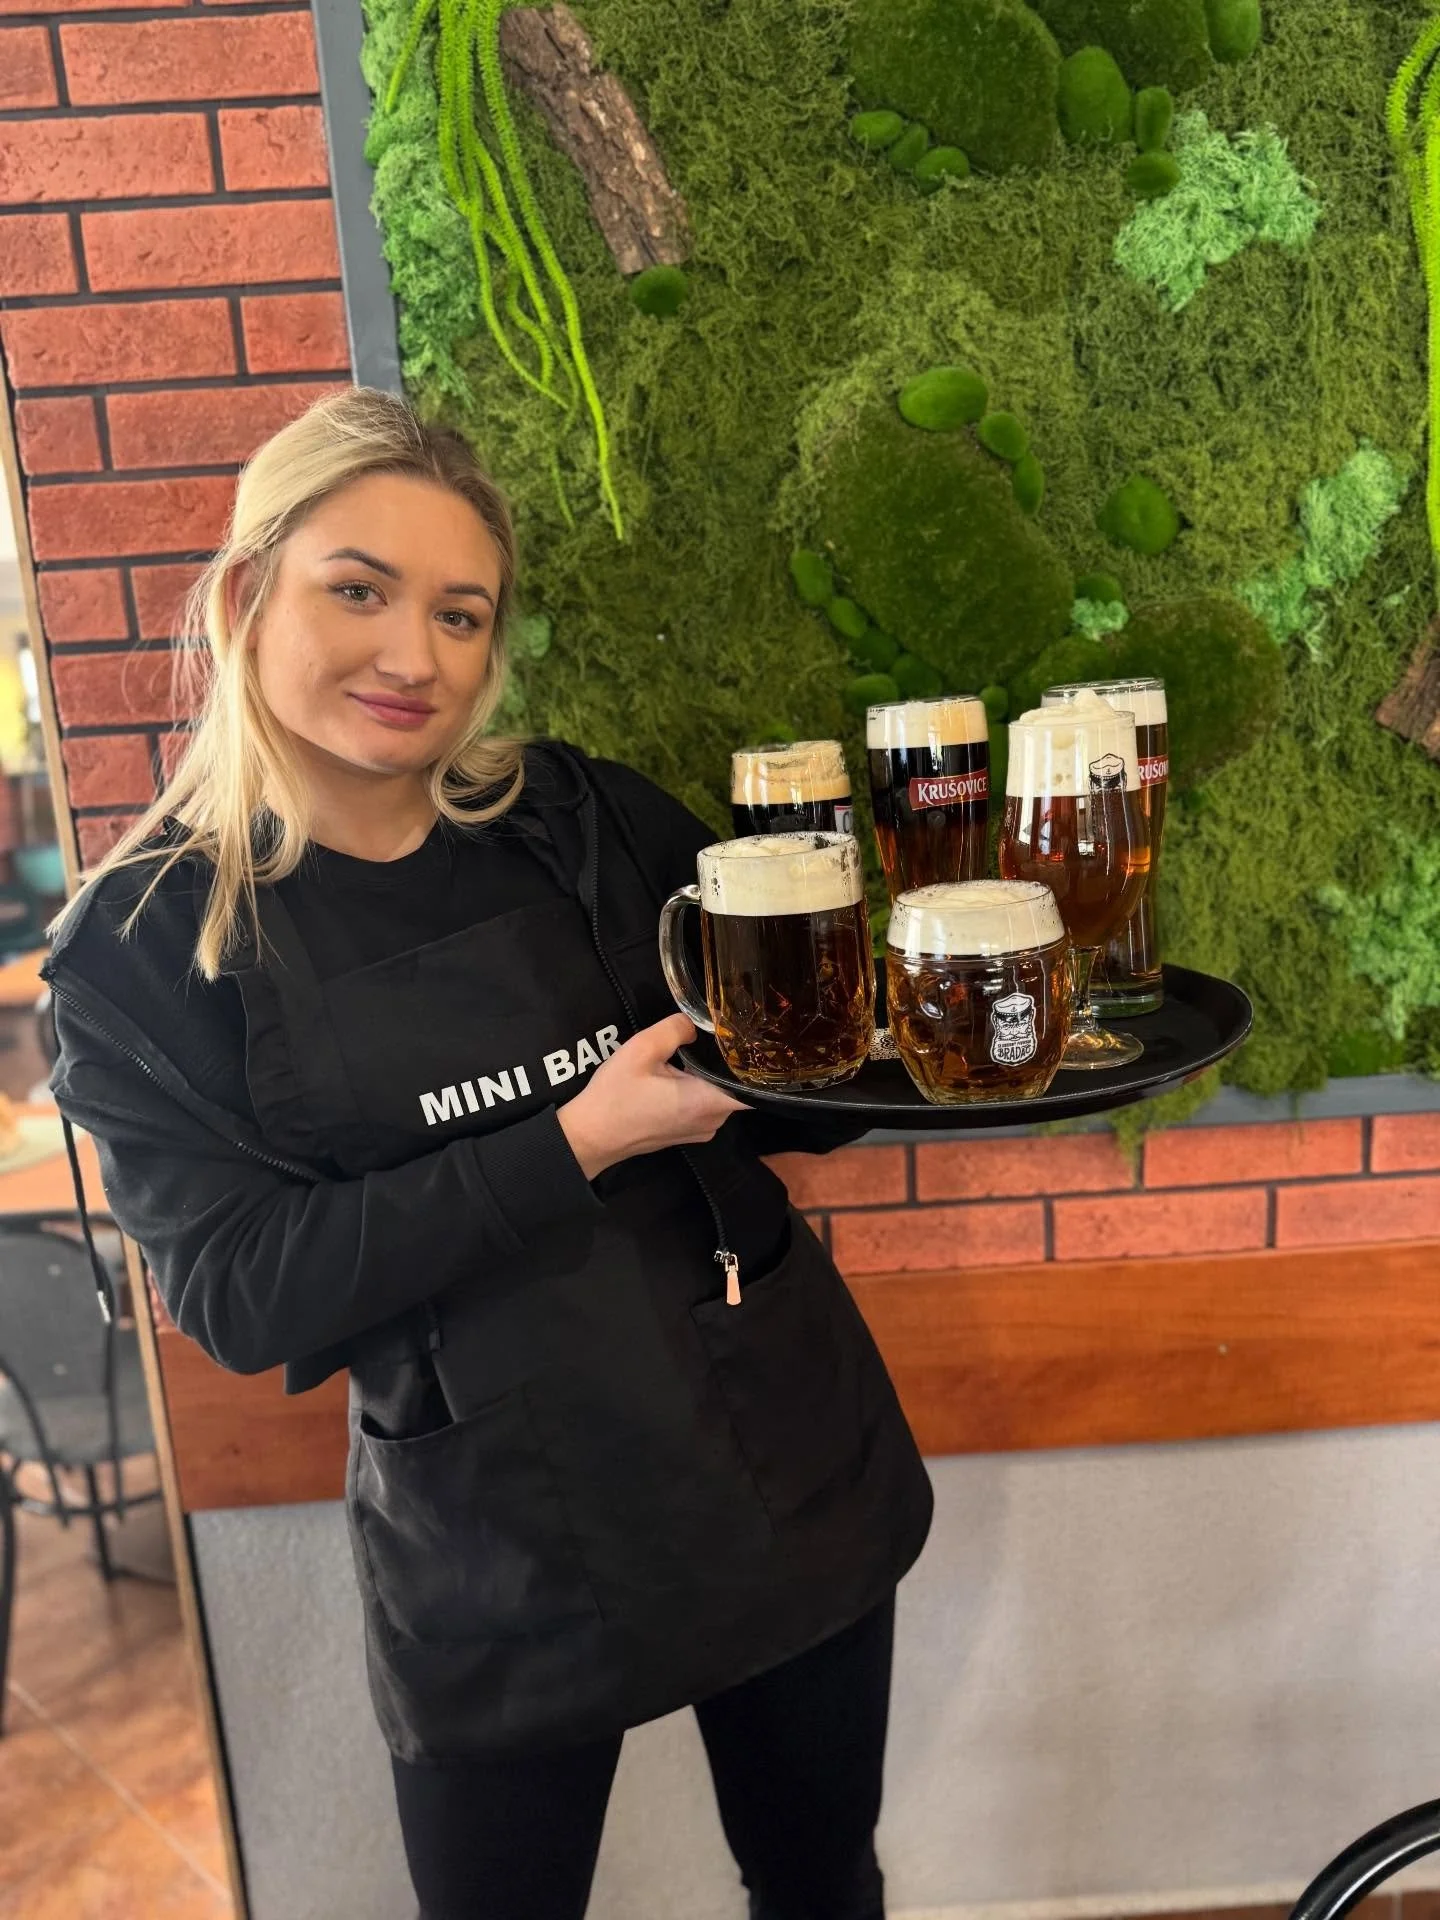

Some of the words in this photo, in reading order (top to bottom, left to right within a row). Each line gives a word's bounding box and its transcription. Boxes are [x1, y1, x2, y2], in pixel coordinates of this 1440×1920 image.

[1139, 760, 1168, 781] RUŠOV
[917, 777, 987, 806] KRUŠOVICE
[419, 1065, 532, 1126] MINI
[543, 1024, 622, 1087] BAR
